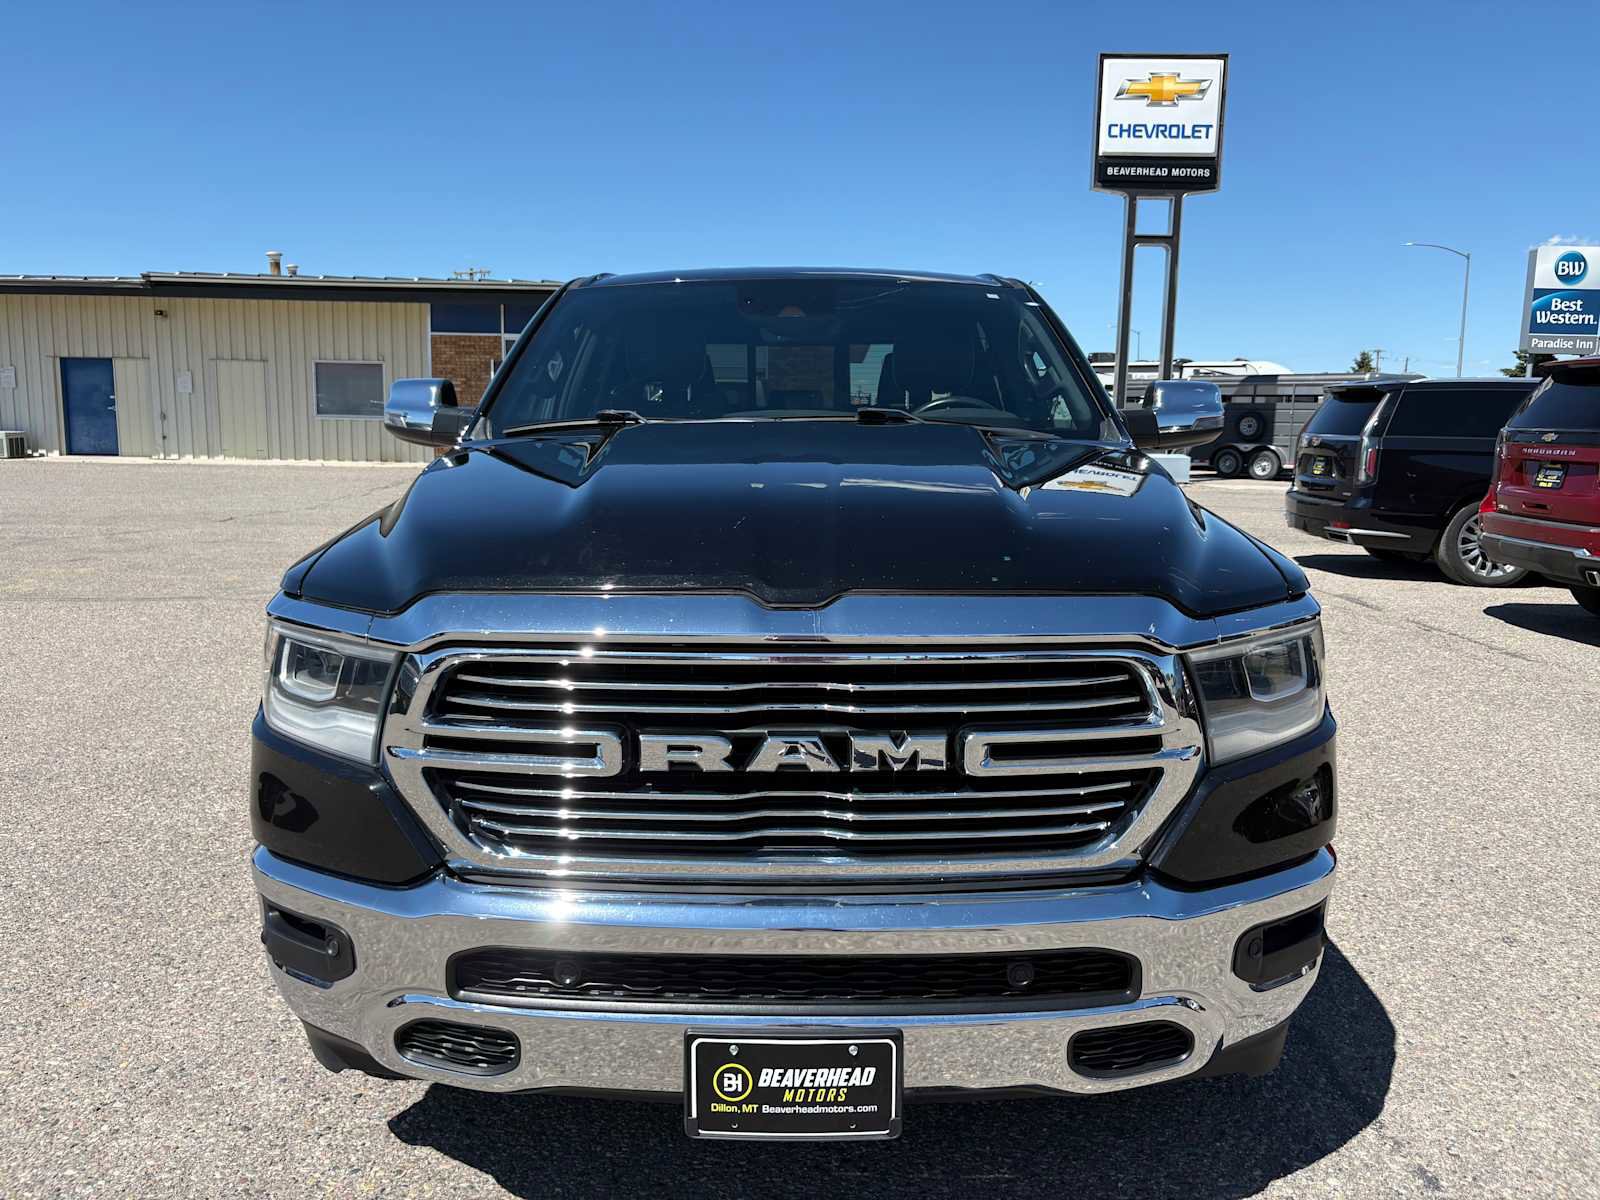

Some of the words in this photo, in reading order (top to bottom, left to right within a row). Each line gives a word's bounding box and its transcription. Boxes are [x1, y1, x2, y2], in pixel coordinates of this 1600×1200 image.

[1107, 123, 1213, 139] CHEVROLET
[1107, 166, 1168, 176] BEAVERHEAD
[1171, 168, 1210, 177] MOTORS
[1557, 261, 1585, 275] BW
[1551, 297, 1584, 311] Best
[1531, 338, 1573, 349] Paradise
[1576, 339, 1593, 349] Inn
[639, 732, 947, 773] RAM
[758, 1067, 876, 1088] BEAVERHEAD
[783, 1088, 848, 1103] MOTORS
[711, 1103, 741, 1114] Dillon,
[742, 1104, 759, 1113] MT
[762, 1104, 878, 1114] Beaverheadmotors.com
